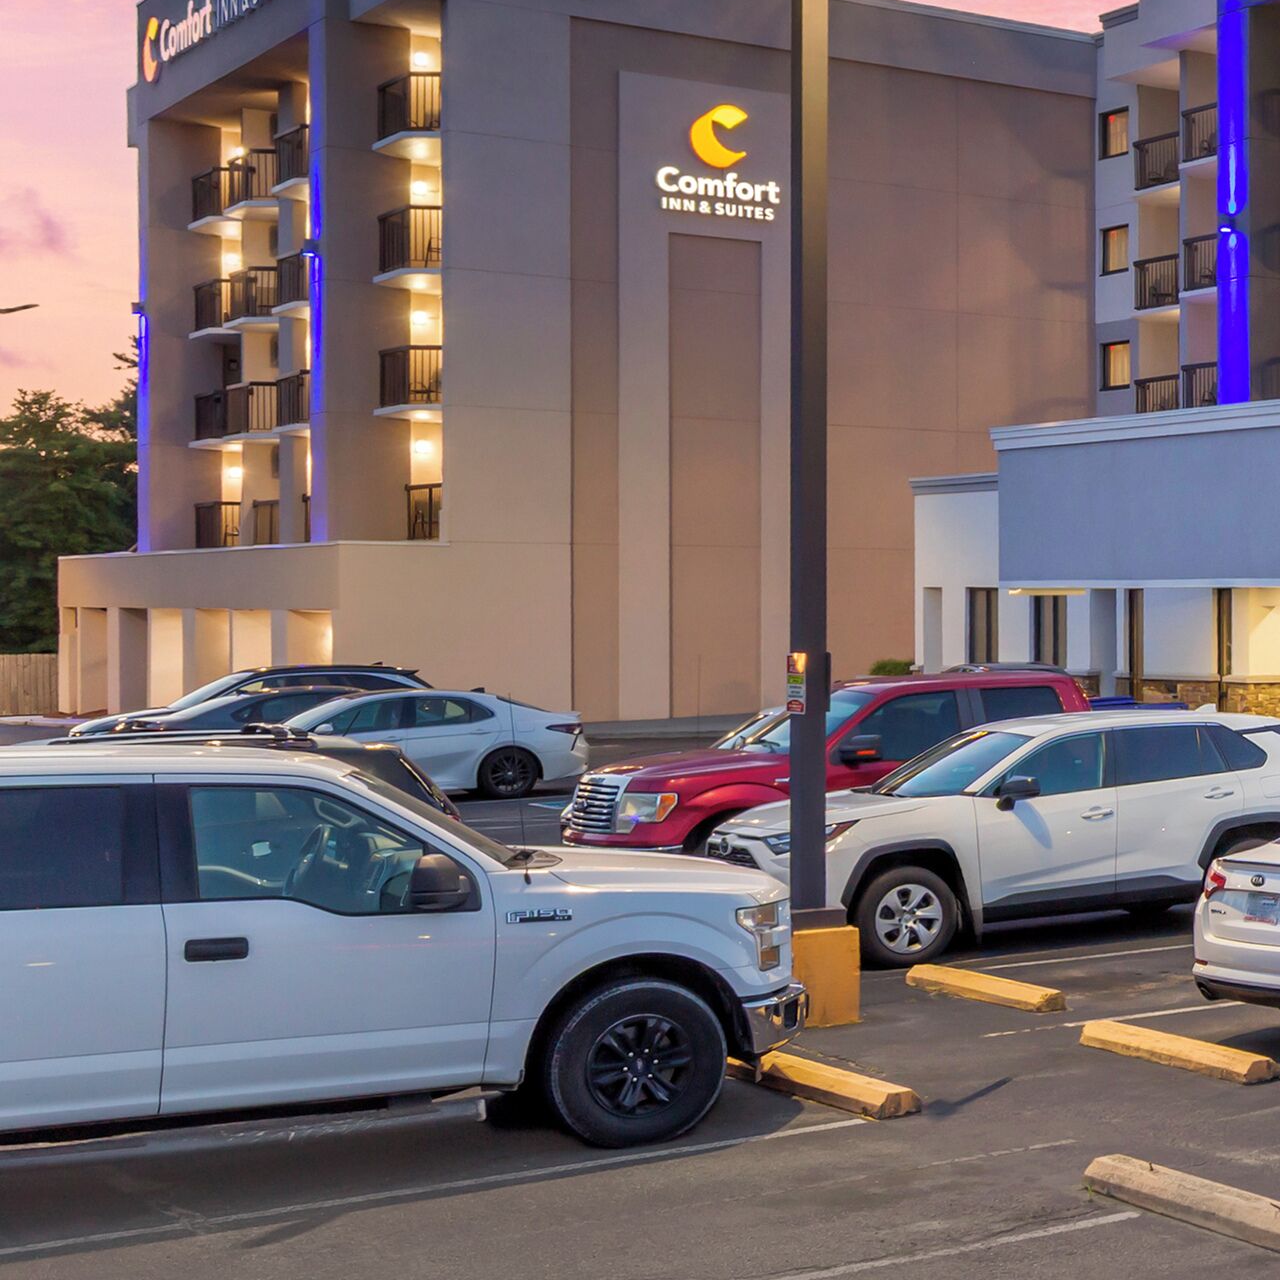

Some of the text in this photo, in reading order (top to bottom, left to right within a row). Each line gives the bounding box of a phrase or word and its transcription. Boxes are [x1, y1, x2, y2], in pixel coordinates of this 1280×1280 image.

[656, 165, 780, 204] Comfort
[661, 197, 775, 221] INN & SUITES
